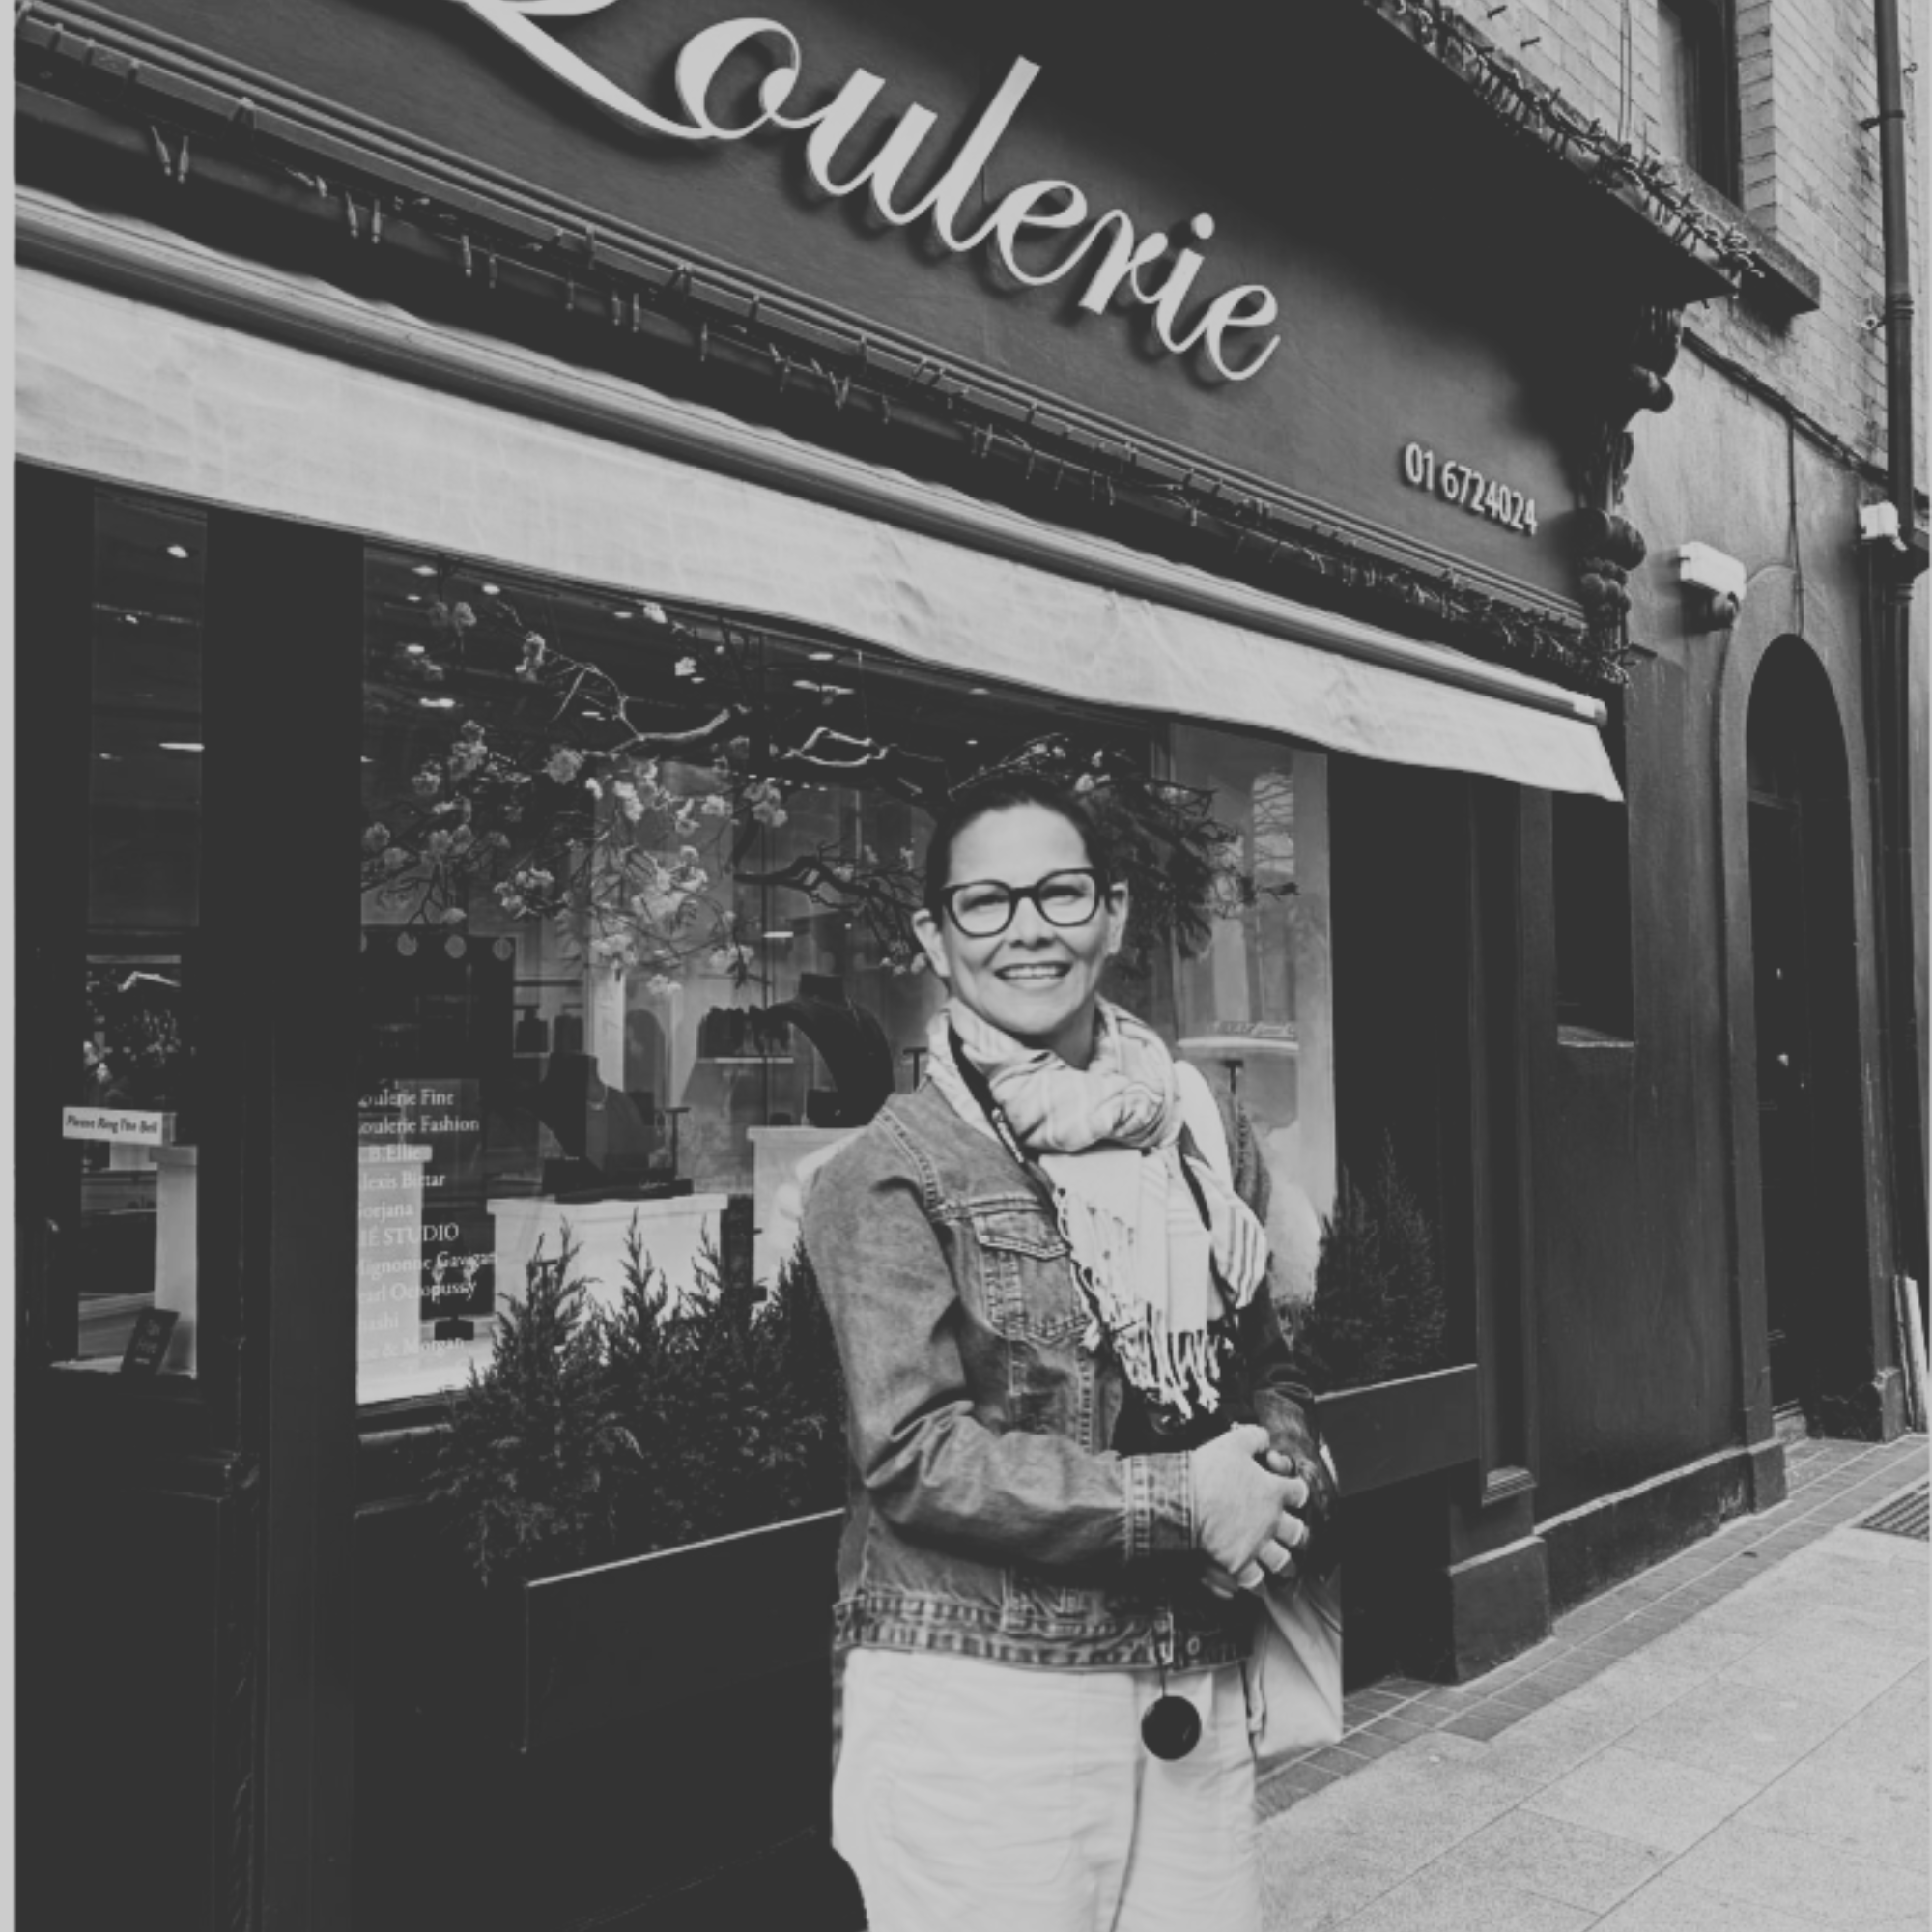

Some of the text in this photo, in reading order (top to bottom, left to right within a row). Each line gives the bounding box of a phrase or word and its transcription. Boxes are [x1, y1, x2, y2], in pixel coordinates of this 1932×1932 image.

[1405, 442, 1537, 535] 01 6724024
[358, 1089, 416, 1107] oulerie
[358, 1115, 480, 1134] oulerie Fashion
[362, 1172, 399, 1190] lexis
[358, 1201, 413, 1224] orjana
[384, 1222, 459, 1246] STUDIO
